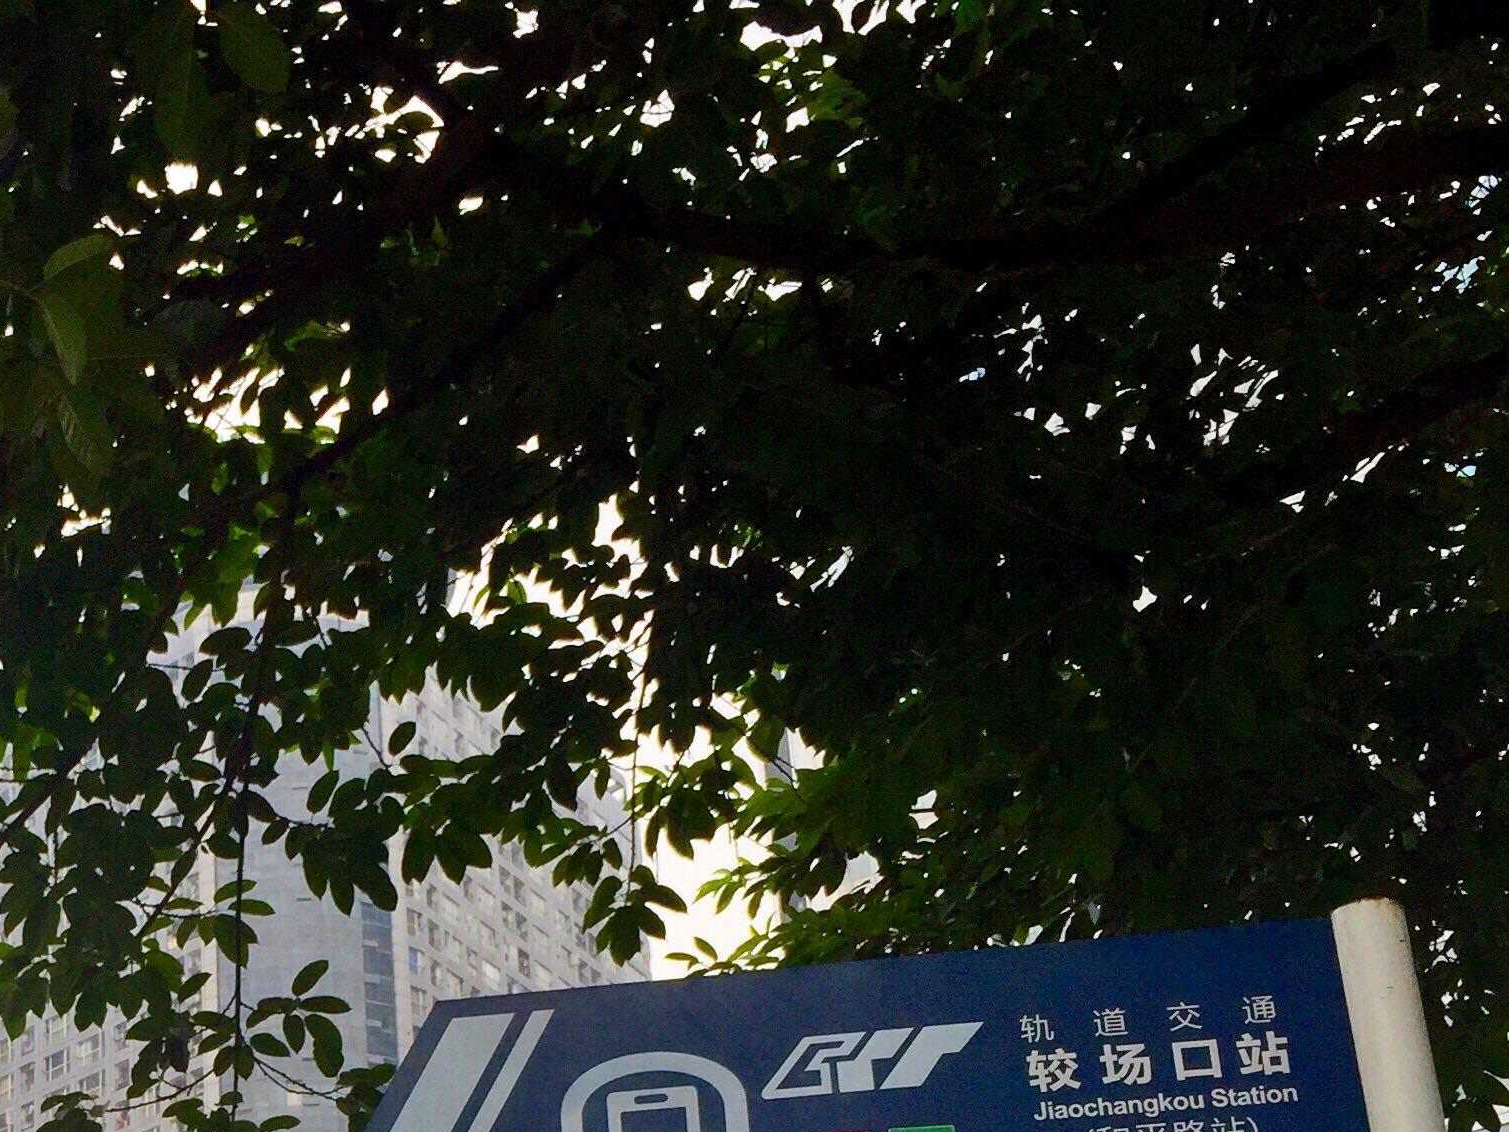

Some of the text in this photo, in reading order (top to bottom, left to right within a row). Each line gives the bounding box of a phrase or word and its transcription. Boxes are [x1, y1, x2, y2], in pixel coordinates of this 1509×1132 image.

[1018, 995, 1278, 1044] 轨道交通
[1026, 1030, 1292, 1093] 较场口站
[1033, 1082, 1299, 1121] Jiaochangkou Station
